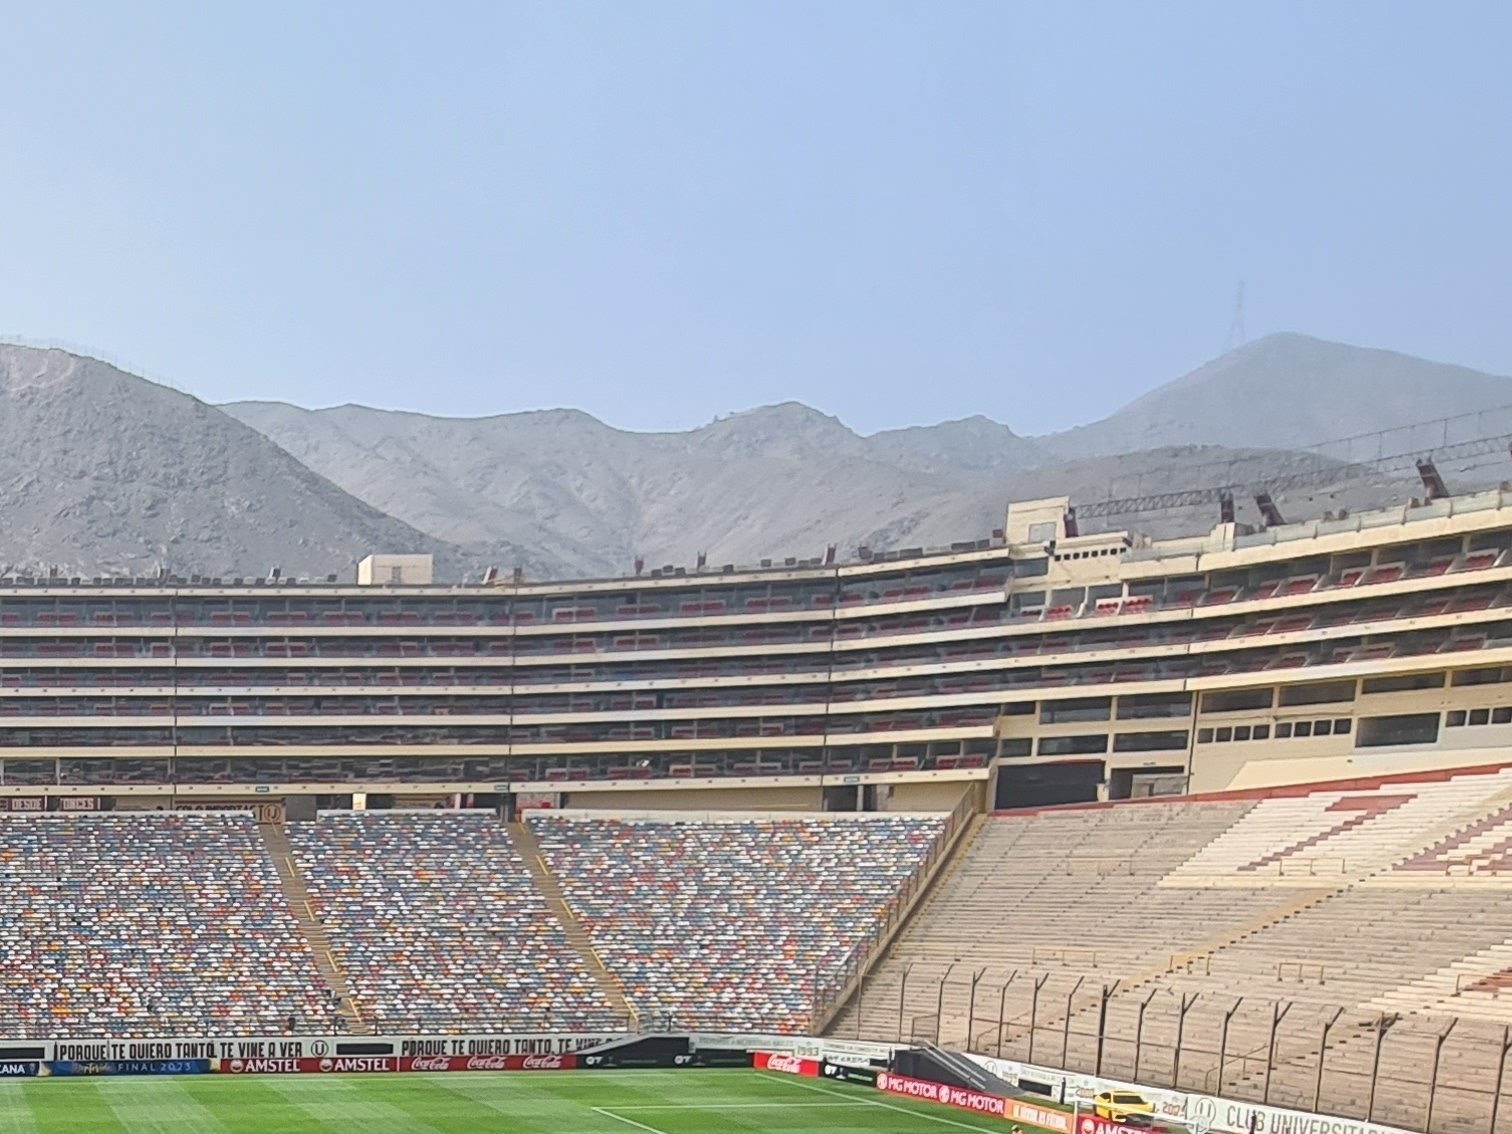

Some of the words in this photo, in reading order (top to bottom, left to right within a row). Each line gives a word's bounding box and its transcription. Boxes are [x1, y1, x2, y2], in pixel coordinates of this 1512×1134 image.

[59, 1043, 107, 1060] PORQUE
[111, 1043, 125, 1060] TE
[129, 1043, 172, 1060] QUIERO
[220, 1042, 234, 1058] TE
[238, 1042, 265, 1058] VINE
[268, 1042, 276, 1057] A
[279, 1041, 302, 1057] VER
[401, 1040, 447, 1056] PORQUE
[451, 1040, 465, 1056] TE
[468, 1039, 511, 1056] QUIERO
[558, 1038, 572, 1055] TE
[117, 1062, 156, 1072] FINAL
[245, 1059, 300, 1072] AMSTEL
[334, 1058, 389, 1071] AMSTEL
[410, 1056, 450, 1071] Coca-Cola
[466, 1056, 506, 1071] Coca-Cola
[522, 1056, 562, 1070] Coca-Cola
[888, 1077, 904, 1092] MG
[904, 1081, 938, 1099] MOTOR
[950, 1090, 967, 1106] MG
[967, 1094, 1004, 1114] MOTOR
